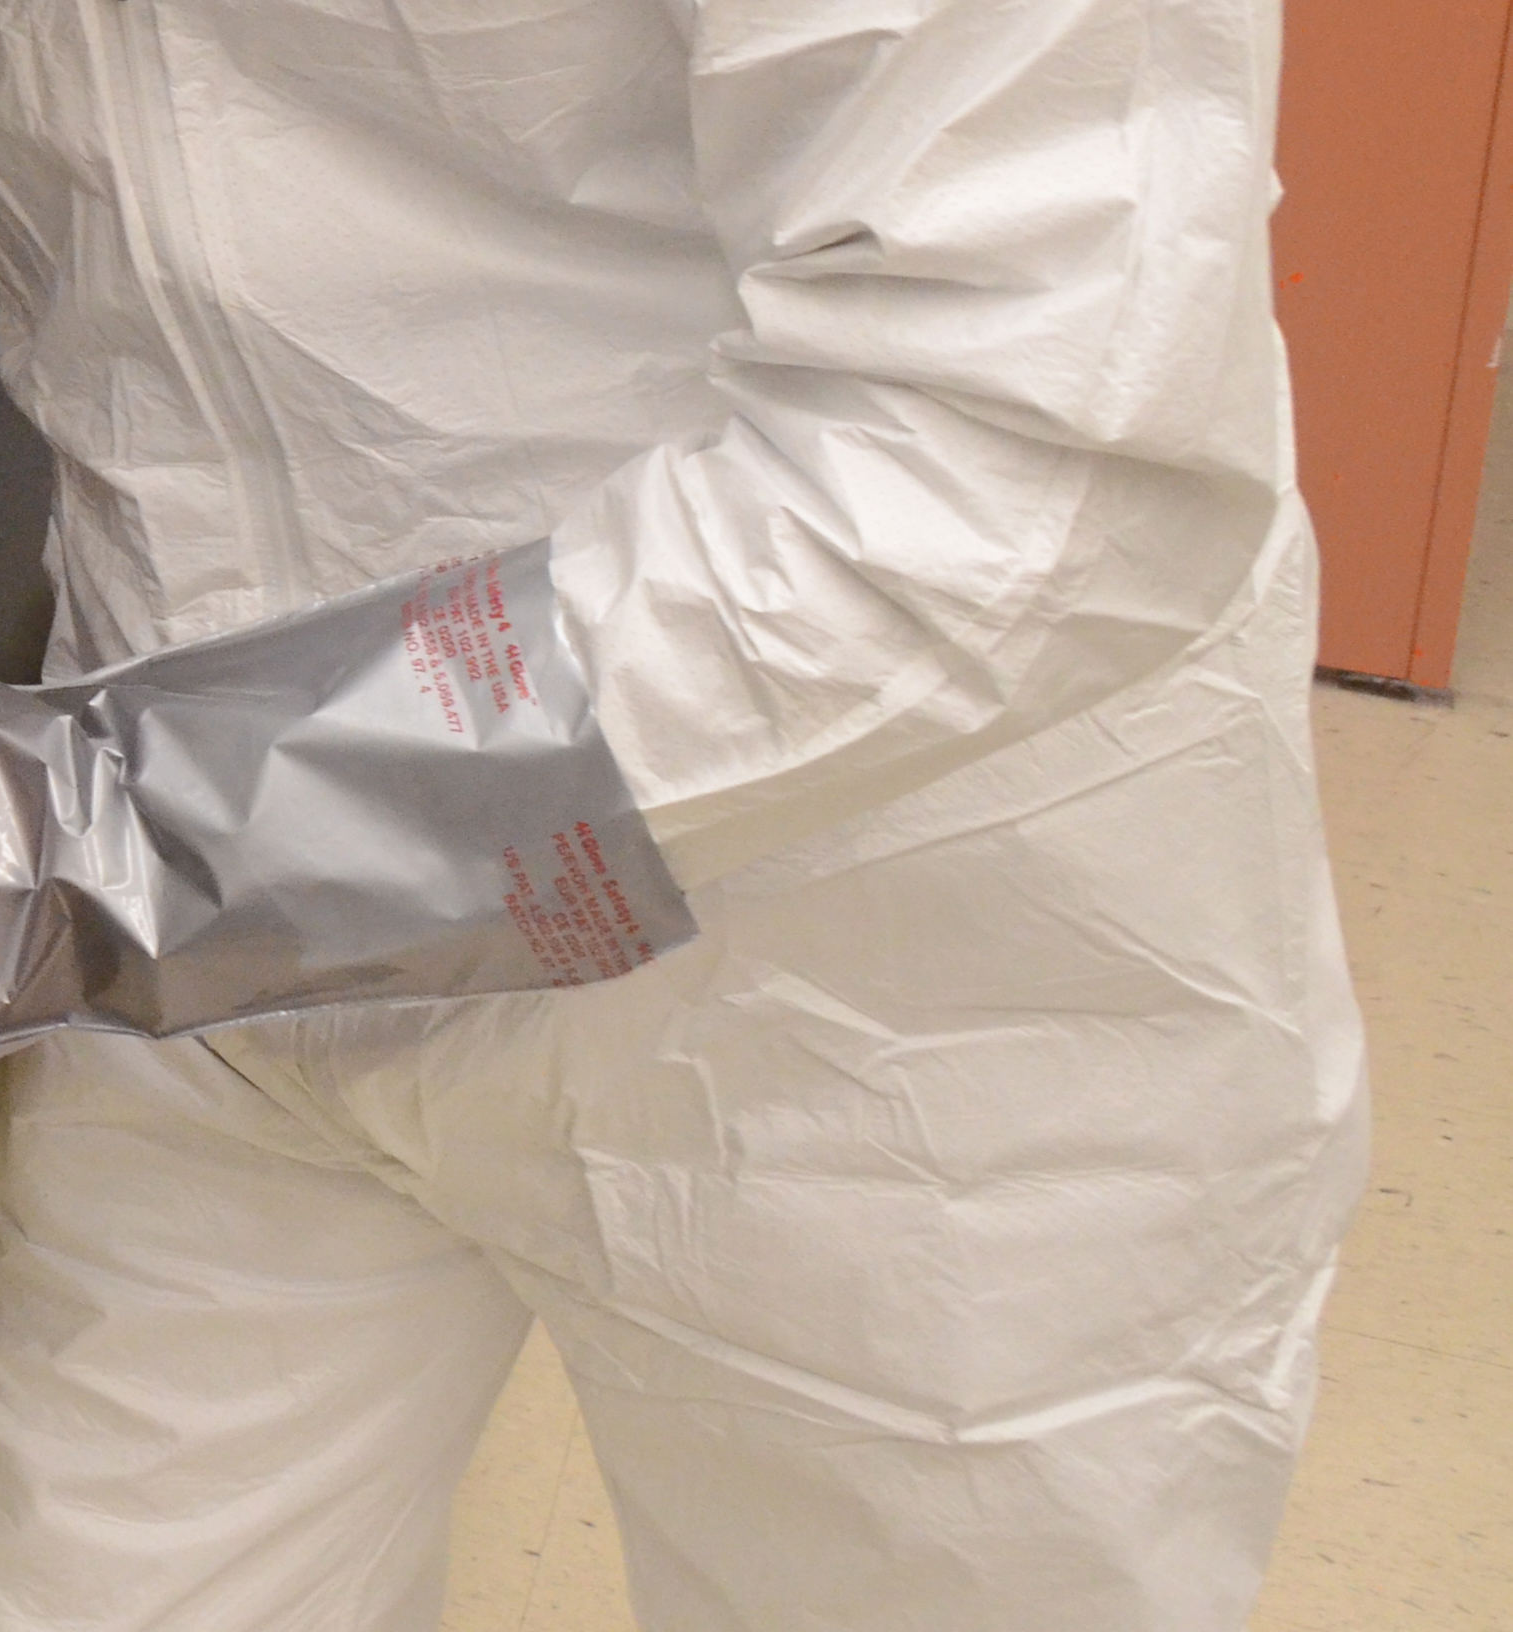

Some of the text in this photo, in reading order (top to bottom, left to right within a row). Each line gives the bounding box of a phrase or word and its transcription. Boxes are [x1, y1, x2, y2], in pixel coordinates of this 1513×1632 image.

[476, 632, 490, 649] IN
[482, 649, 501, 679] THE
[491, 681, 511, 714] USA
